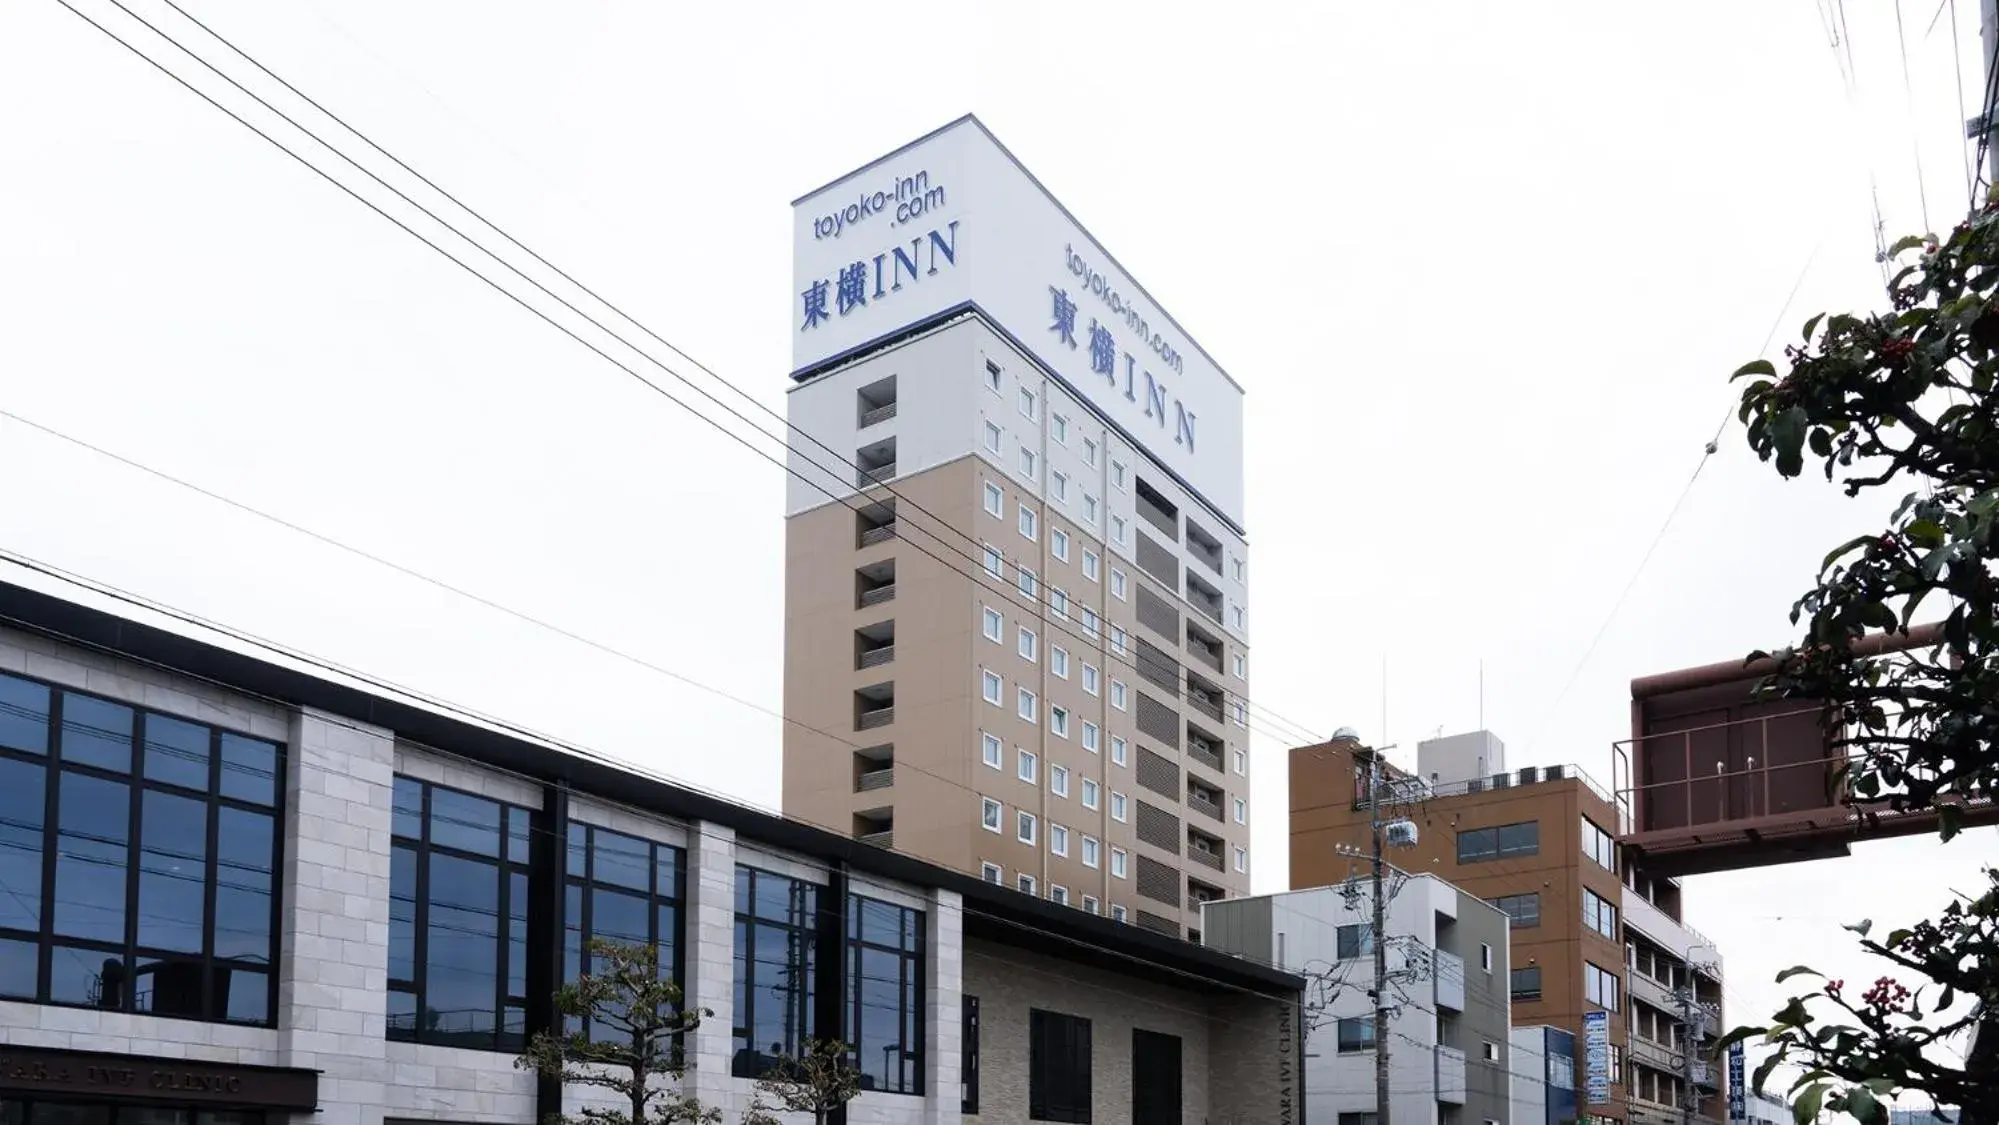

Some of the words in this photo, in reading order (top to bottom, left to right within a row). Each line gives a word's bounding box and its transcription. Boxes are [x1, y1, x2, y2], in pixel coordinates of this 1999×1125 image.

[813, 168, 928, 240] toyoko-inn
[890, 182, 945, 229] .com
[1064, 242, 1184, 376] toyoko-inn.com
[86, 1065, 137, 1087] IVF
[151, 1069, 242, 1093] CLINIC
